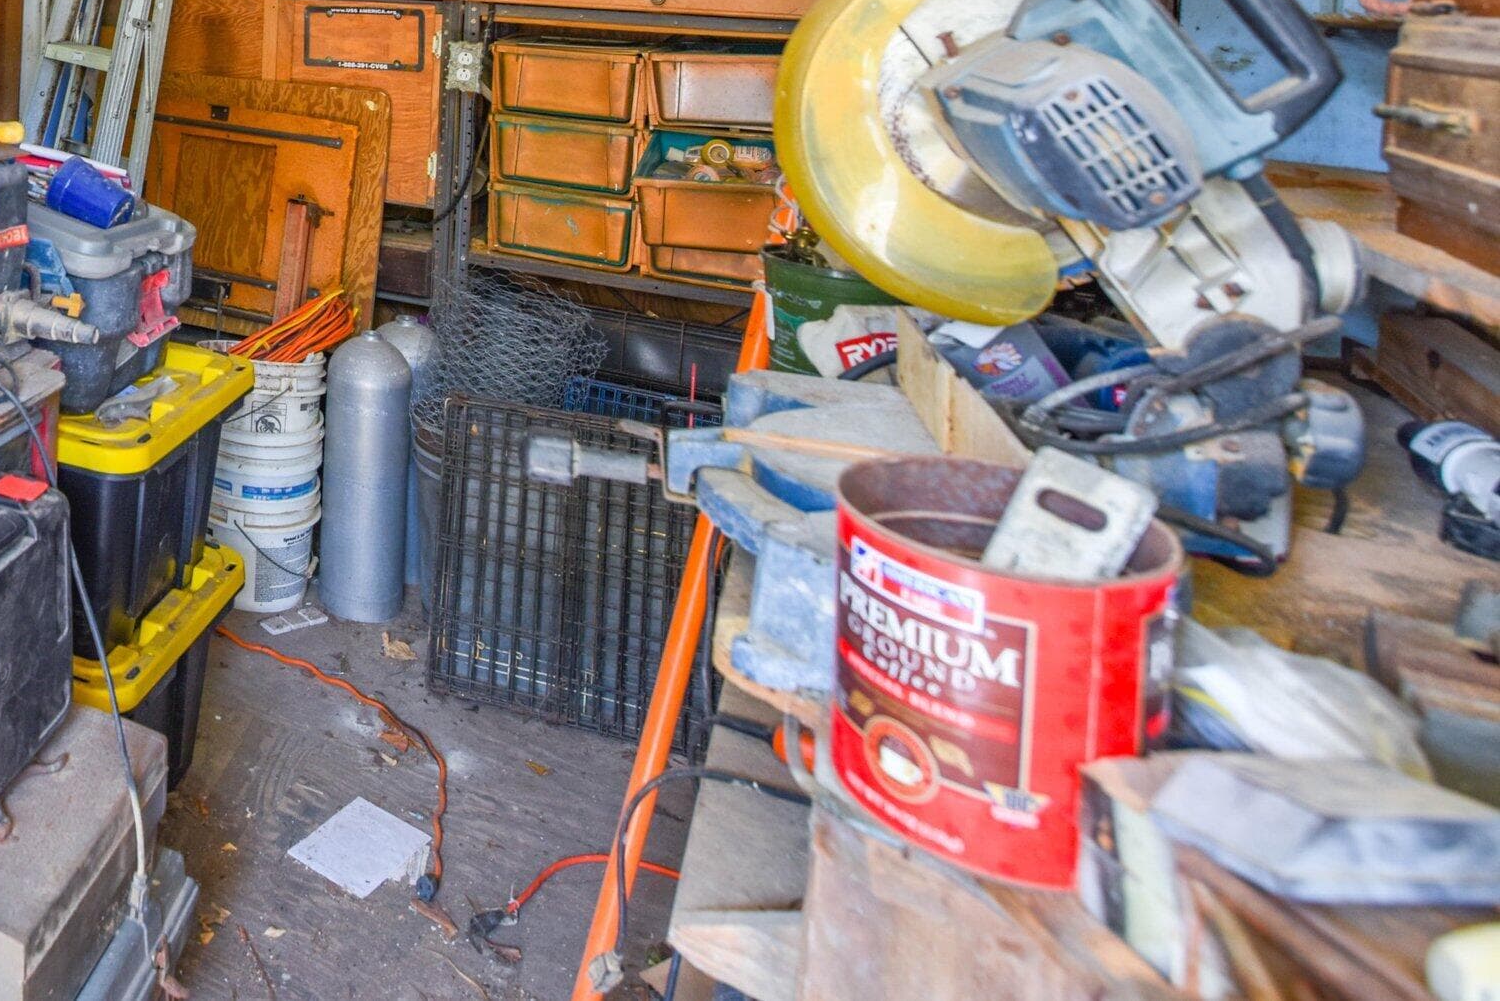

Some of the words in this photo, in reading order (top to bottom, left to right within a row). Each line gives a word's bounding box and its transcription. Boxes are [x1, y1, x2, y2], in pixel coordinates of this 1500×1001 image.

[839, 570, 1023, 689] PREMIUM
[847, 613, 977, 693] GROUND
[862, 642, 943, 698] Coffee
